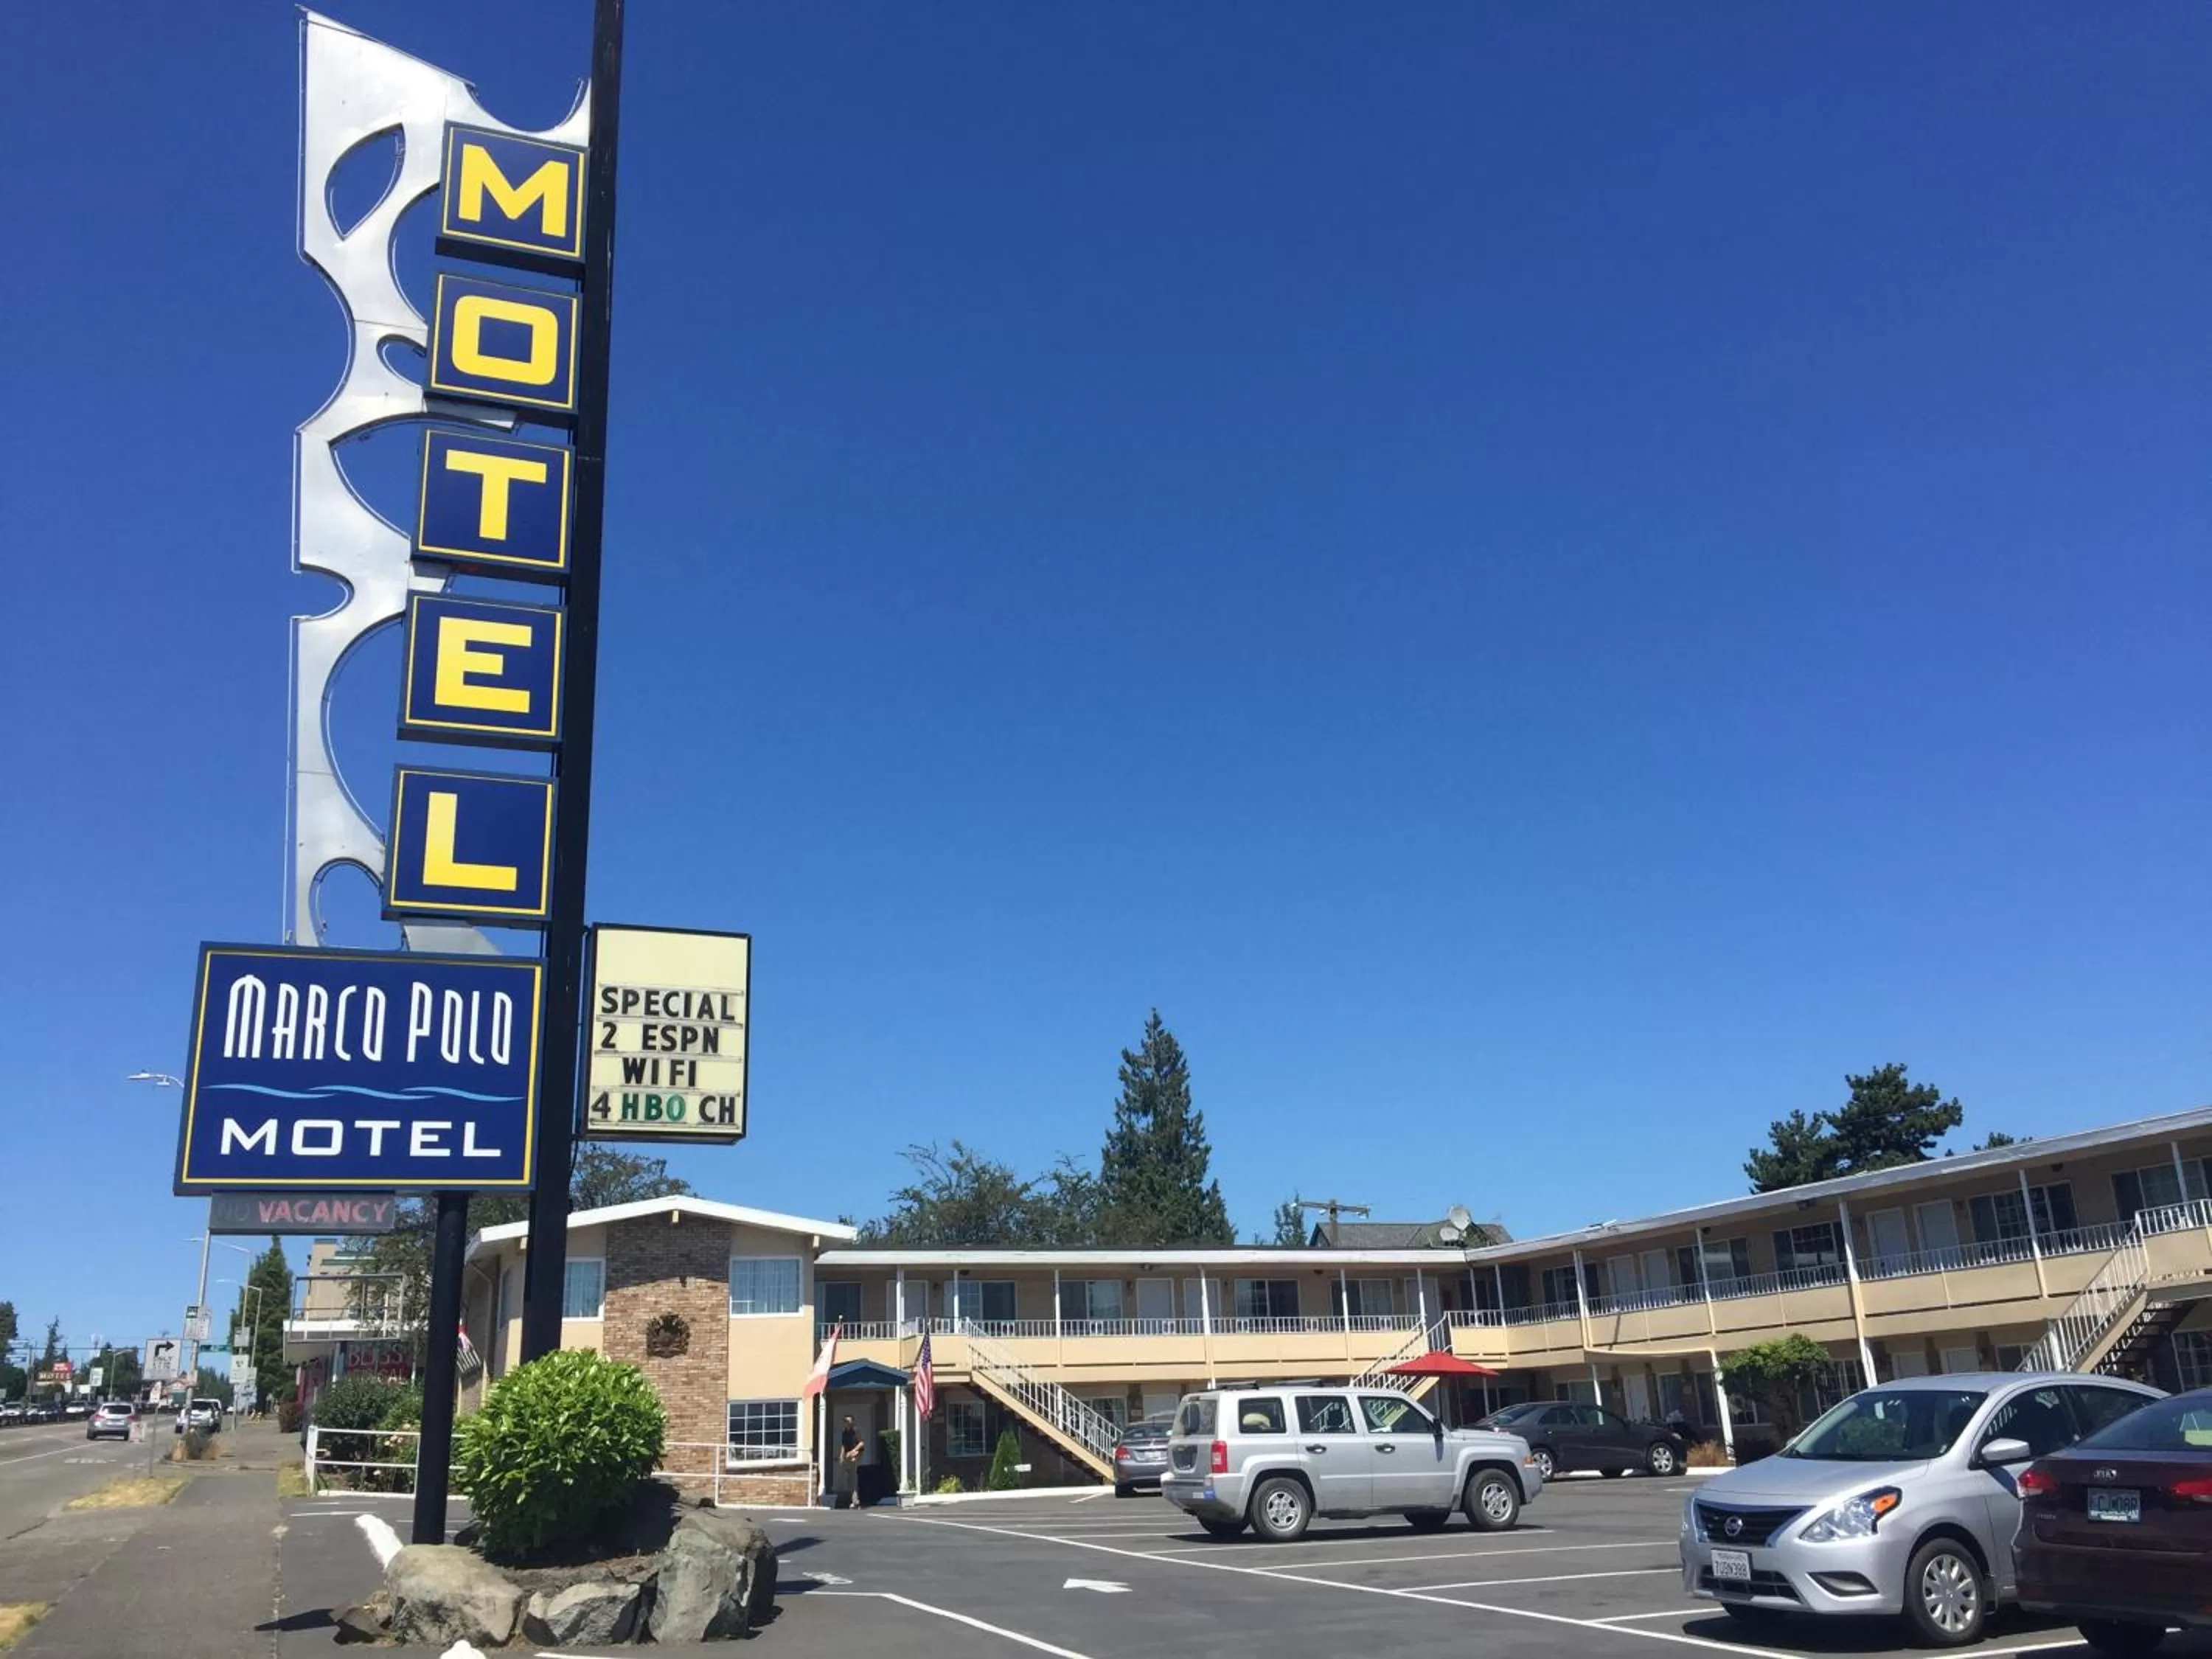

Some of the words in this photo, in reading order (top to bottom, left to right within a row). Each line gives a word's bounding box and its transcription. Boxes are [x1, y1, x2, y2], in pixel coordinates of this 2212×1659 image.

[422, 143, 569, 891] MOTEL
[223, 974, 386, 1062] MARCO
[406, 981, 513, 1065] POLO
[601, 987, 735, 1020] SPECIAL
[601, 1022, 617, 1048] 2
[642, 1024, 719, 1053] ESPN
[591, 1091, 611, 1119] 4
[622, 1093, 686, 1121] HBO
[698, 1095, 735, 1123] CH
[220, 1118, 501, 1157] MOTEL
[259, 1200, 391, 1223] VACANCY
